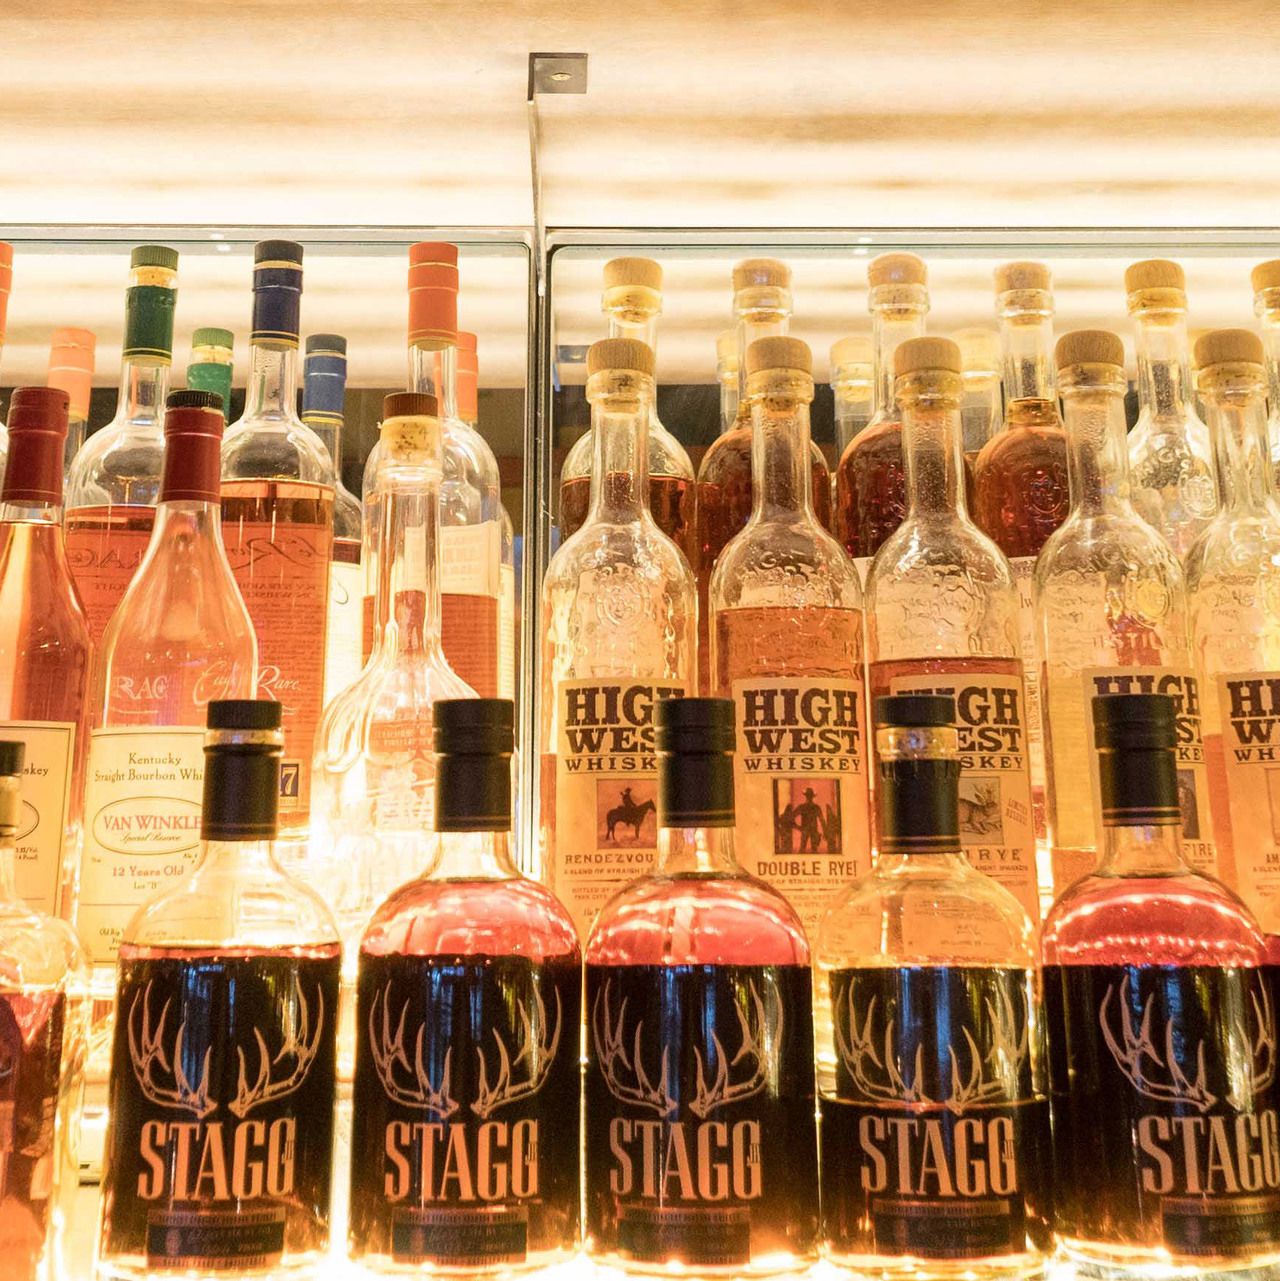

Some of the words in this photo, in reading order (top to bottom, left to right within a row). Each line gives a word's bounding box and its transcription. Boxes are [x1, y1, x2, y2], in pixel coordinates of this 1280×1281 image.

[743, 688, 858, 728] HIGH
[743, 726, 860, 754] WEST
[128, 753, 182, 766] Kentucky
[744, 756, 861, 772] WHISKEY
[94, 768, 125, 783] Straight
[128, 768, 177, 781] Bourbon
[104, 816, 134, 830] VAN
[134, 813, 202, 830] WINKLE
[112, 867, 125, 878] 12
[129, 866, 161, 878] Years
[164, 865, 185, 877] Old
[757, 860, 823, 878] DOUBLE
[136, 1117, 298, 1203] STAGG
[382, 1120, 539, 1202] STAGG
[609, 1118, 762, 1201] STAGG
[858, 1116, 1018, 1198] STAGG
